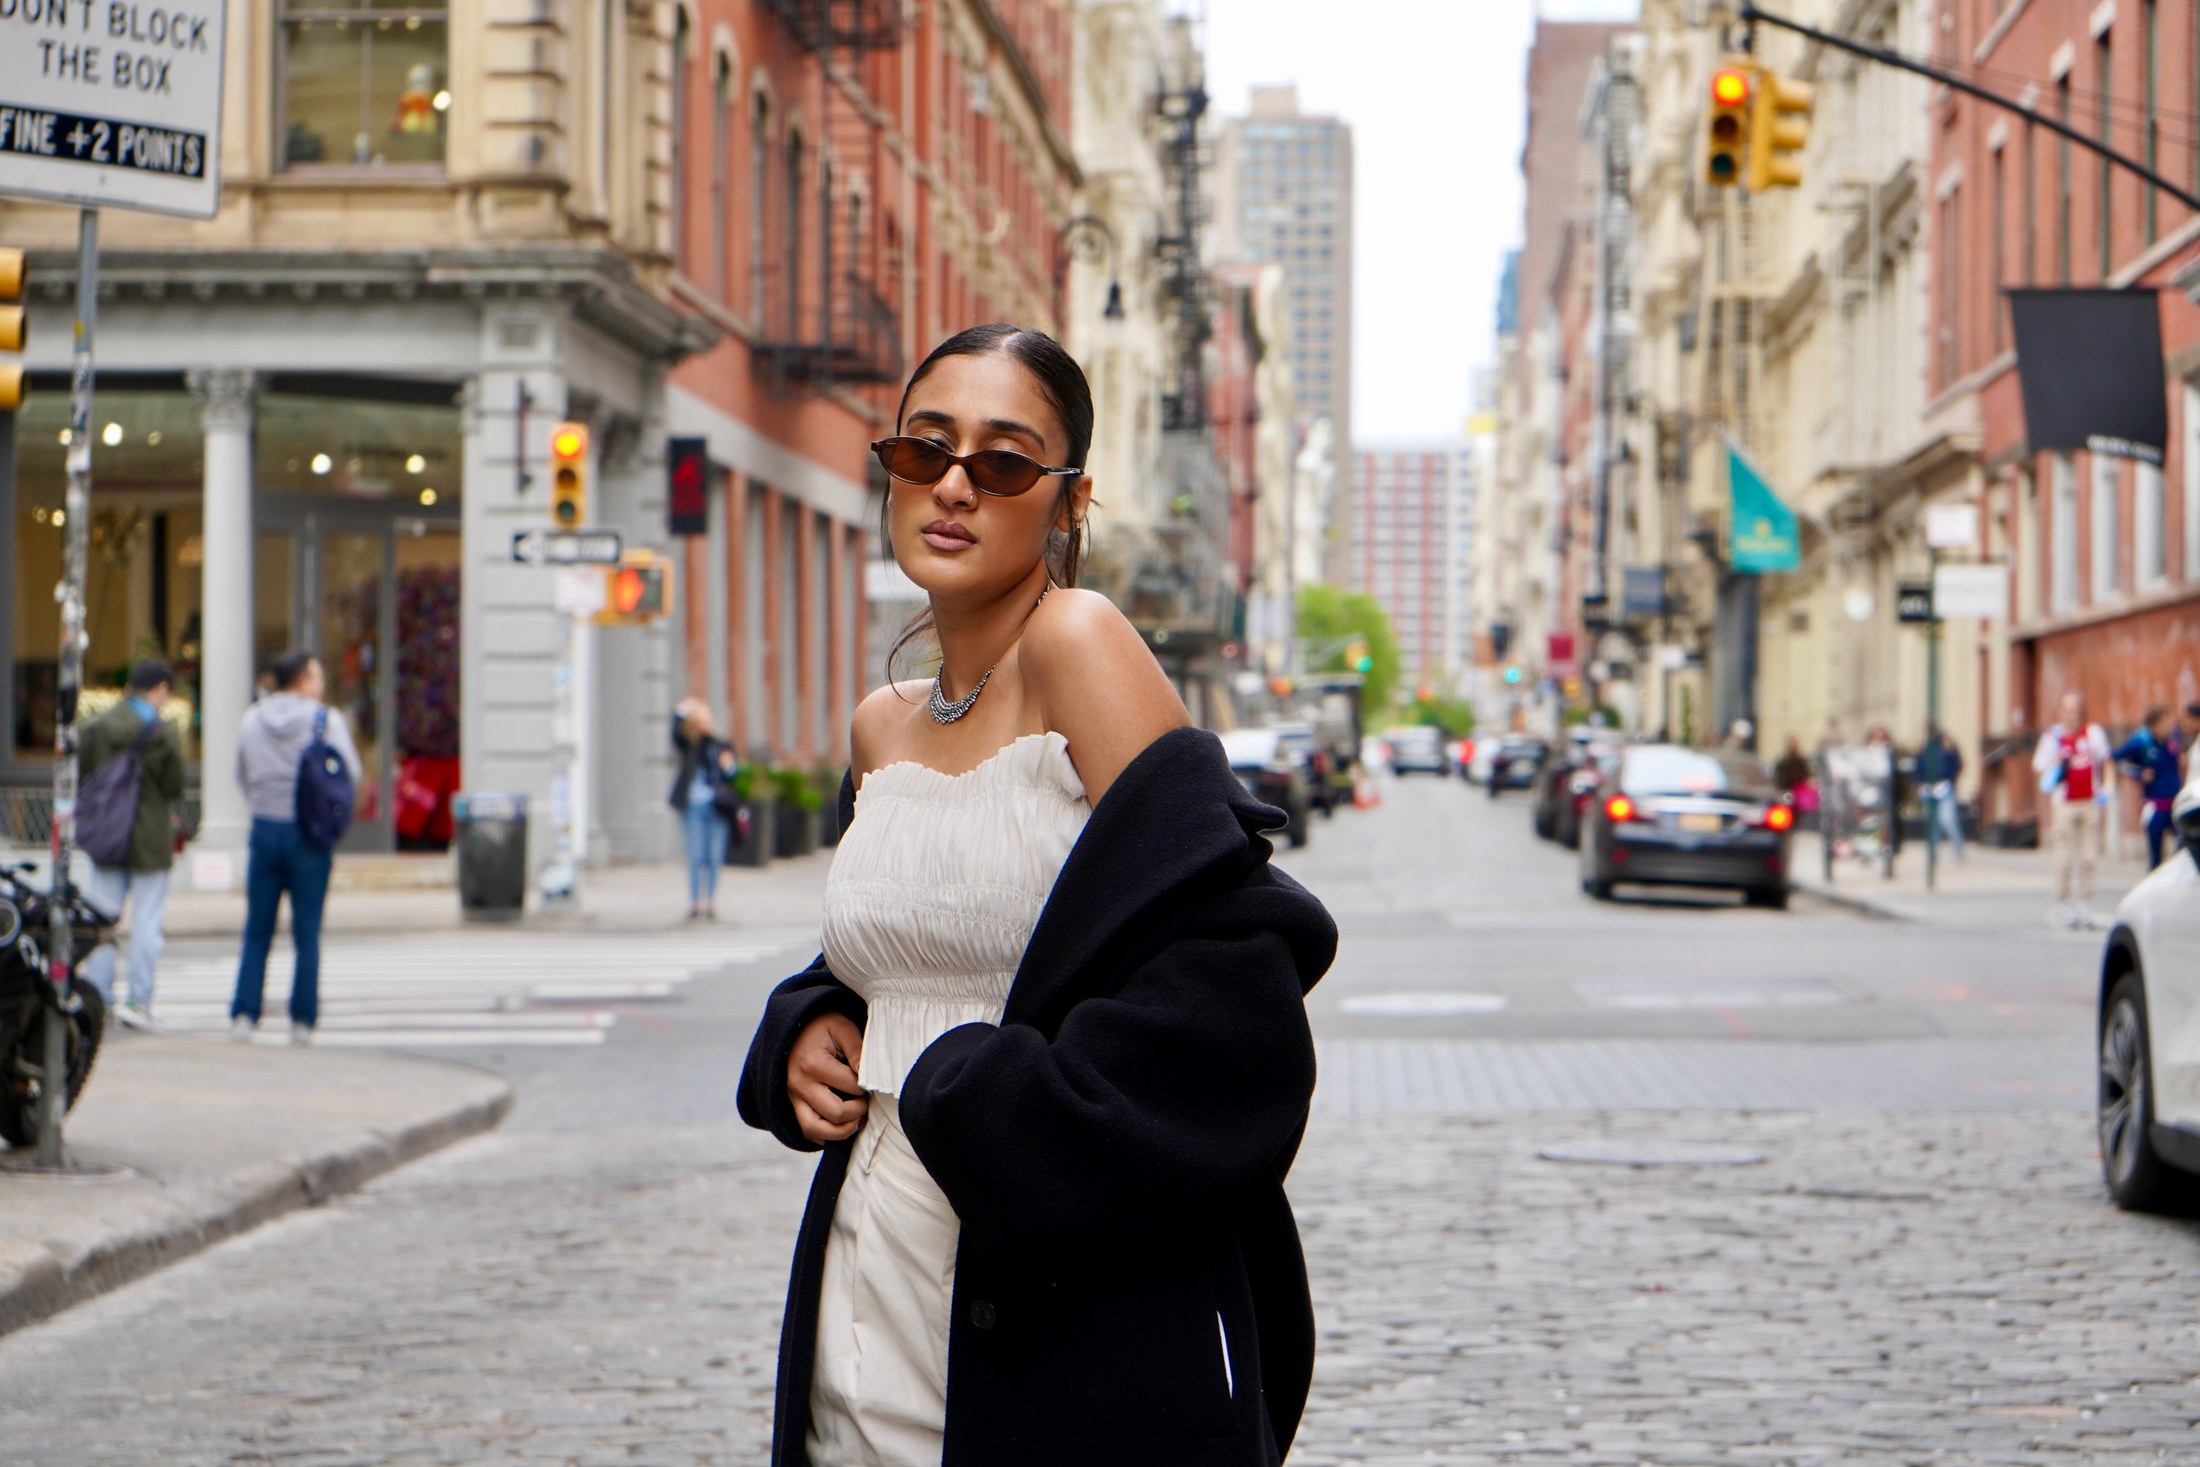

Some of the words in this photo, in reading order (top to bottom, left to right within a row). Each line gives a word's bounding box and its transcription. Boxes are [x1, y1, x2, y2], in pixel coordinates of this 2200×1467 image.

[0, 0, 96, 32] DONT
[108, 2, 207, 53] BLOCK
[38, 38, 100, 84] THE
[113, 51, 172, 95] BOX
[0, 108, 57, 154] FINE
[66, 121, 111, 162] +2
[117, 125, 201, 175] POINTS
